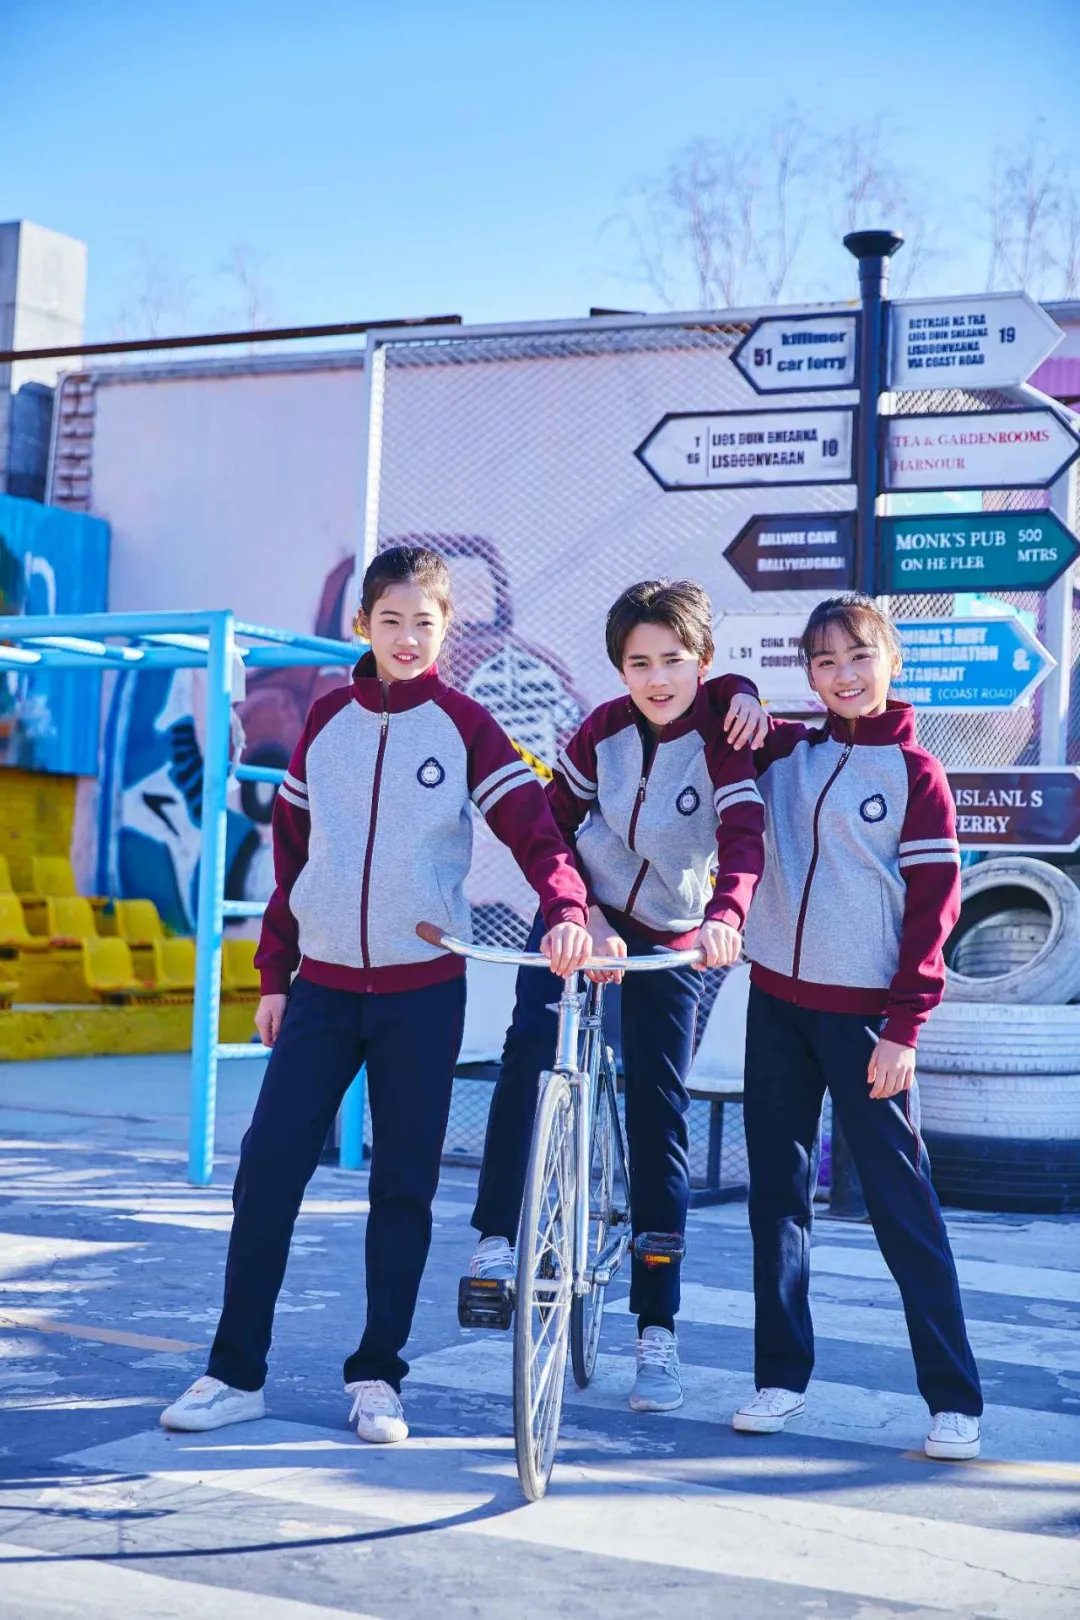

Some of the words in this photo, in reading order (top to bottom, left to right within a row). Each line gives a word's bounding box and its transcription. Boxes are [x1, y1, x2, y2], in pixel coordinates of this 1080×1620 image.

[999, 326, 1016, 343] 19
[754, 348, 772, 367] 51
[777, 358, 804, 372] car
[807, 355, 847, 370] ferry
[925, 355, 956, 368] COAST
[958, 354, 986, 366] ROAD
[893, 435, 921, 448] TEA
[924, 436, 935, 446] &
[896, 531, 967, 550] MONK'S
[970, 530, 1006, 548] PUB
[1018, 528, 1043, 543] 500
[1017, 547, 1058, 563] MTRS
[901, 557, 923, 571] ON
[926, 557, 947, 570] HE
[740, 647, 753, 659] 51
[1012, 648, 1032, 671] &
[895, 667, 966, 683] STAURANT
[938, 687, 979, 701] (COAST
[981, 687, 1017, 700] ROAD)
